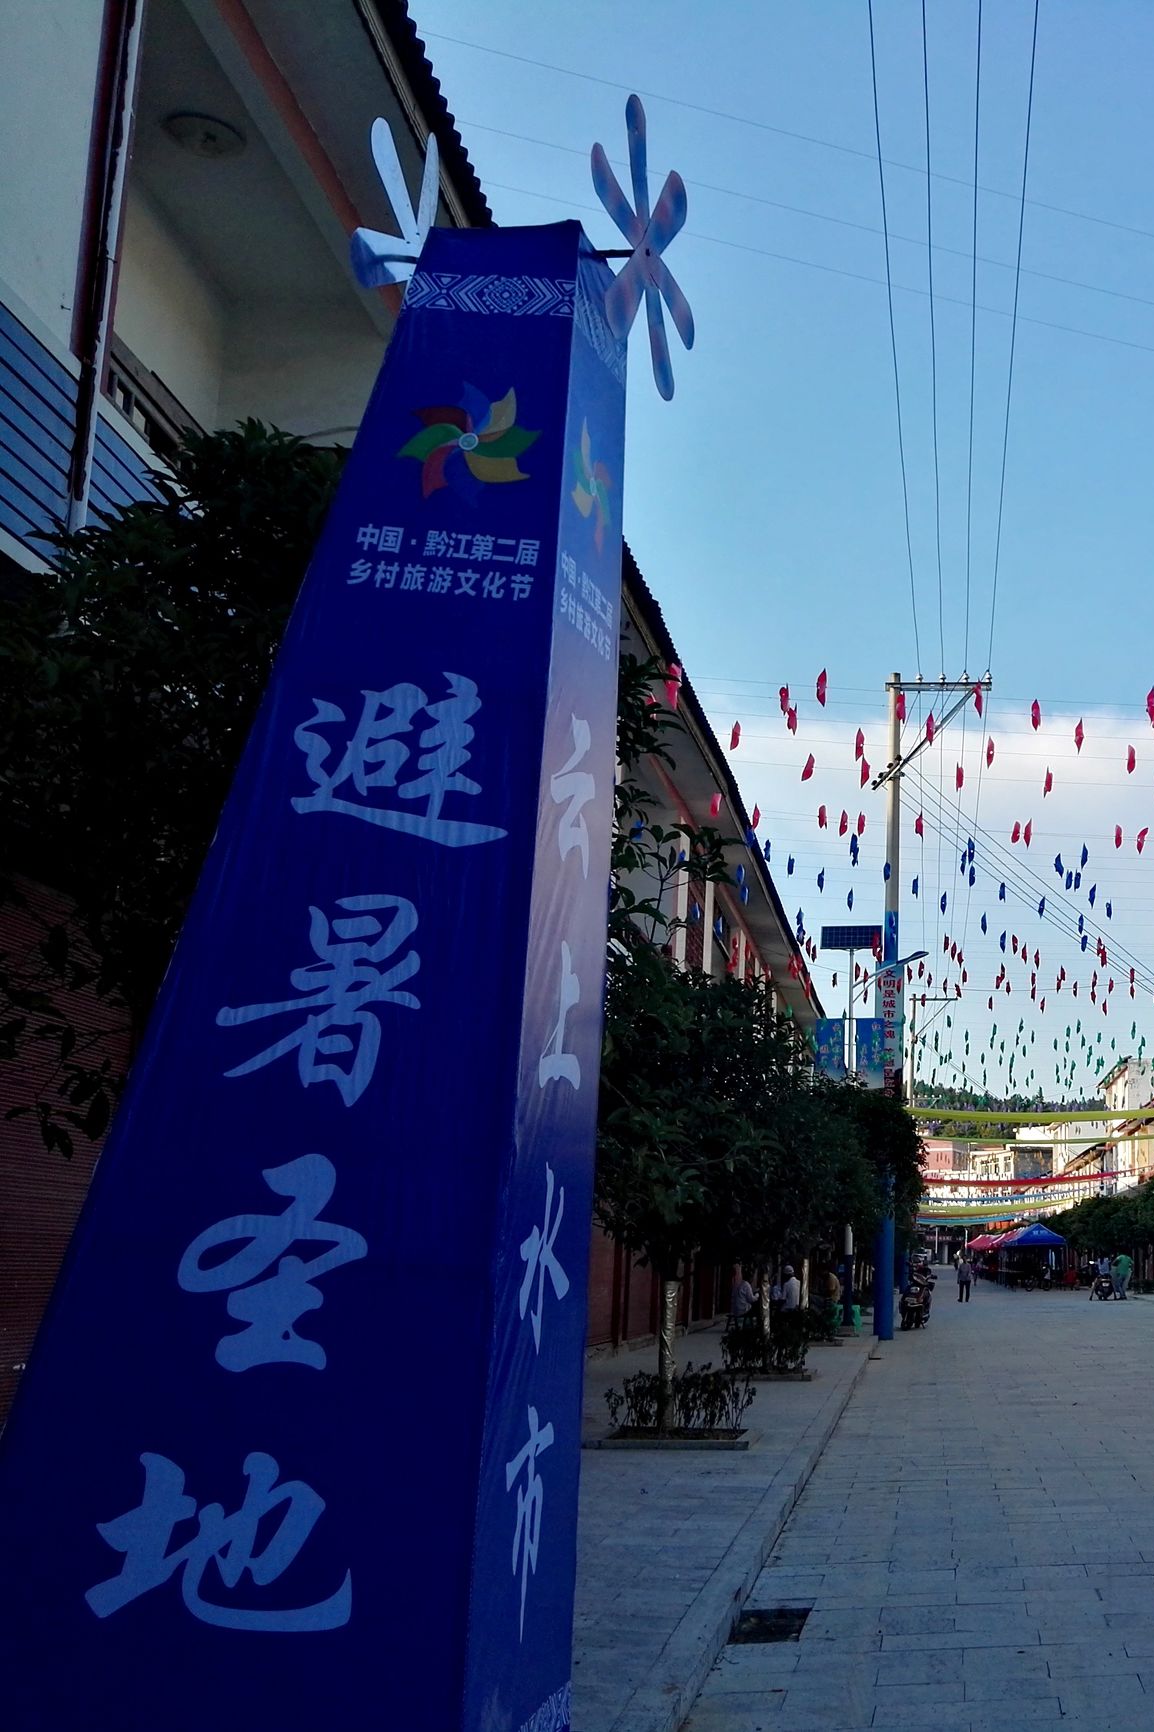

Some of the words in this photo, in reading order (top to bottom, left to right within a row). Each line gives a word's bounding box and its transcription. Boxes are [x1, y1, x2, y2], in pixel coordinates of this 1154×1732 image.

[346, 559, 534, 601] 乡村旅游文化节
[85, 671, 509, 1632] 避暑圣地
